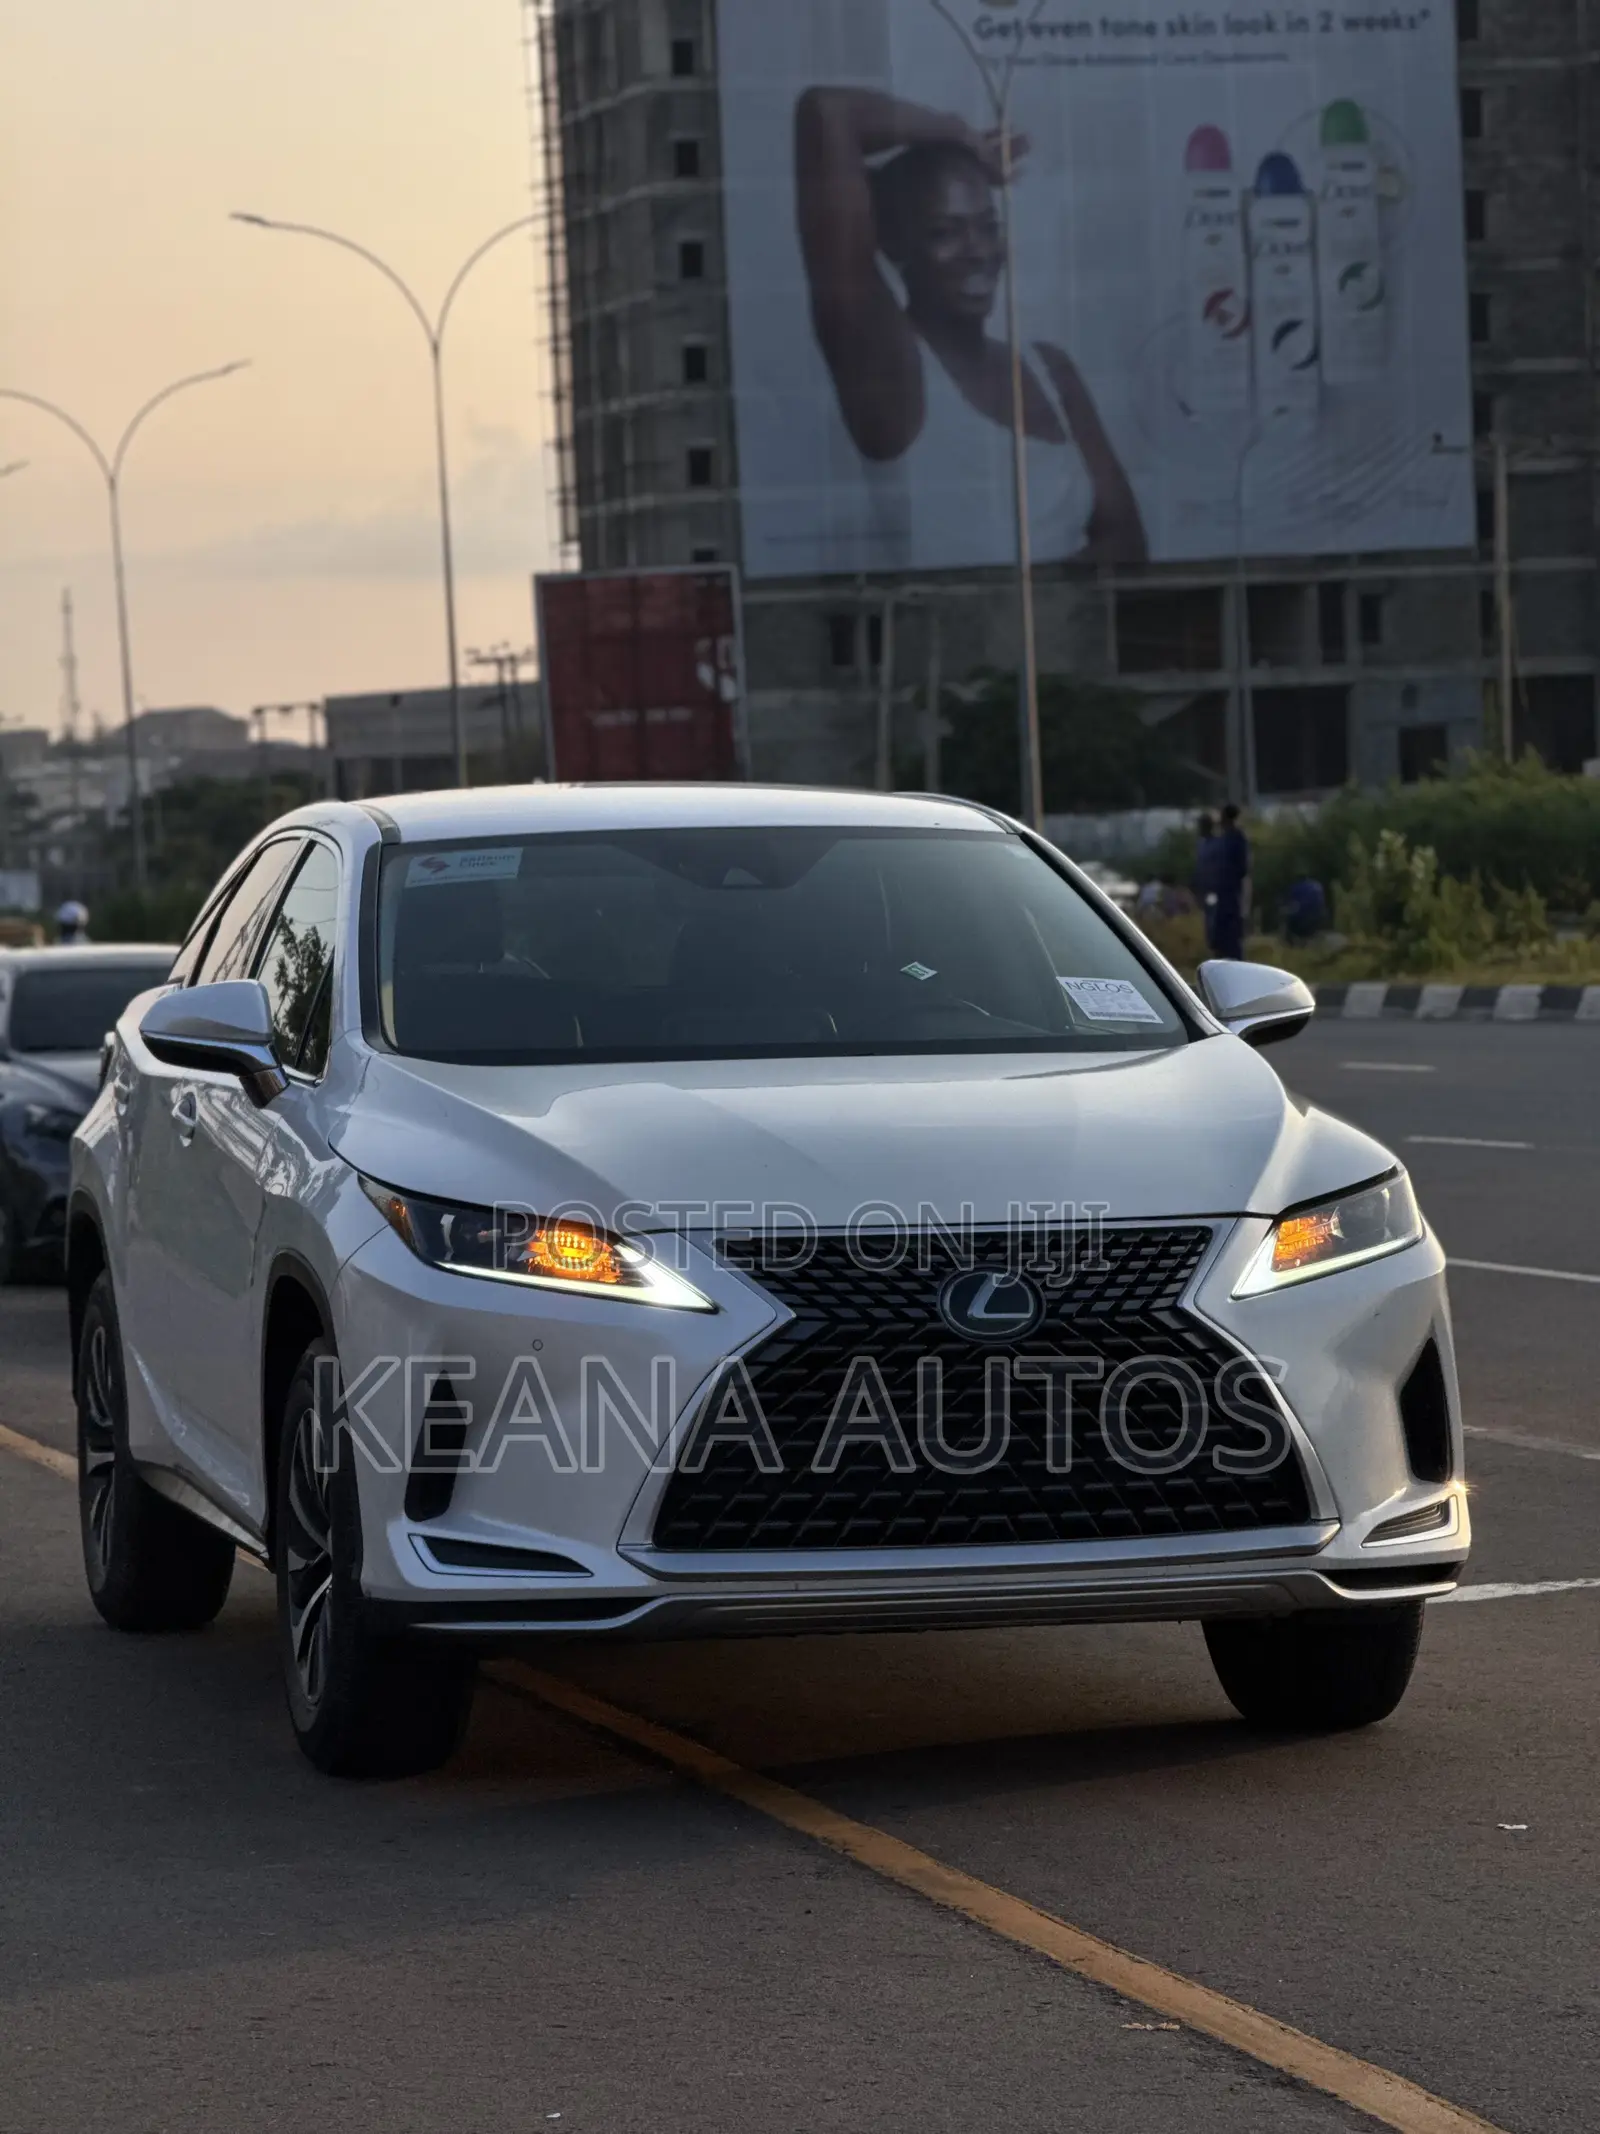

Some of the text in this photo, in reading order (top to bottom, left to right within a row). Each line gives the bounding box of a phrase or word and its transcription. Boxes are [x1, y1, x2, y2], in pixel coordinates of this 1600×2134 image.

[1027, 18, 1093, 38] even
[1099, 16, 1157, 37] tone
[1165, 11, 1217, 37] skin
[1224, 10, 1279, 36] look
[1285, 9, 1310, 34] in
[1317, 9, 1335, 33] 2
[1065, 981, 1134, 994] NGLOS
